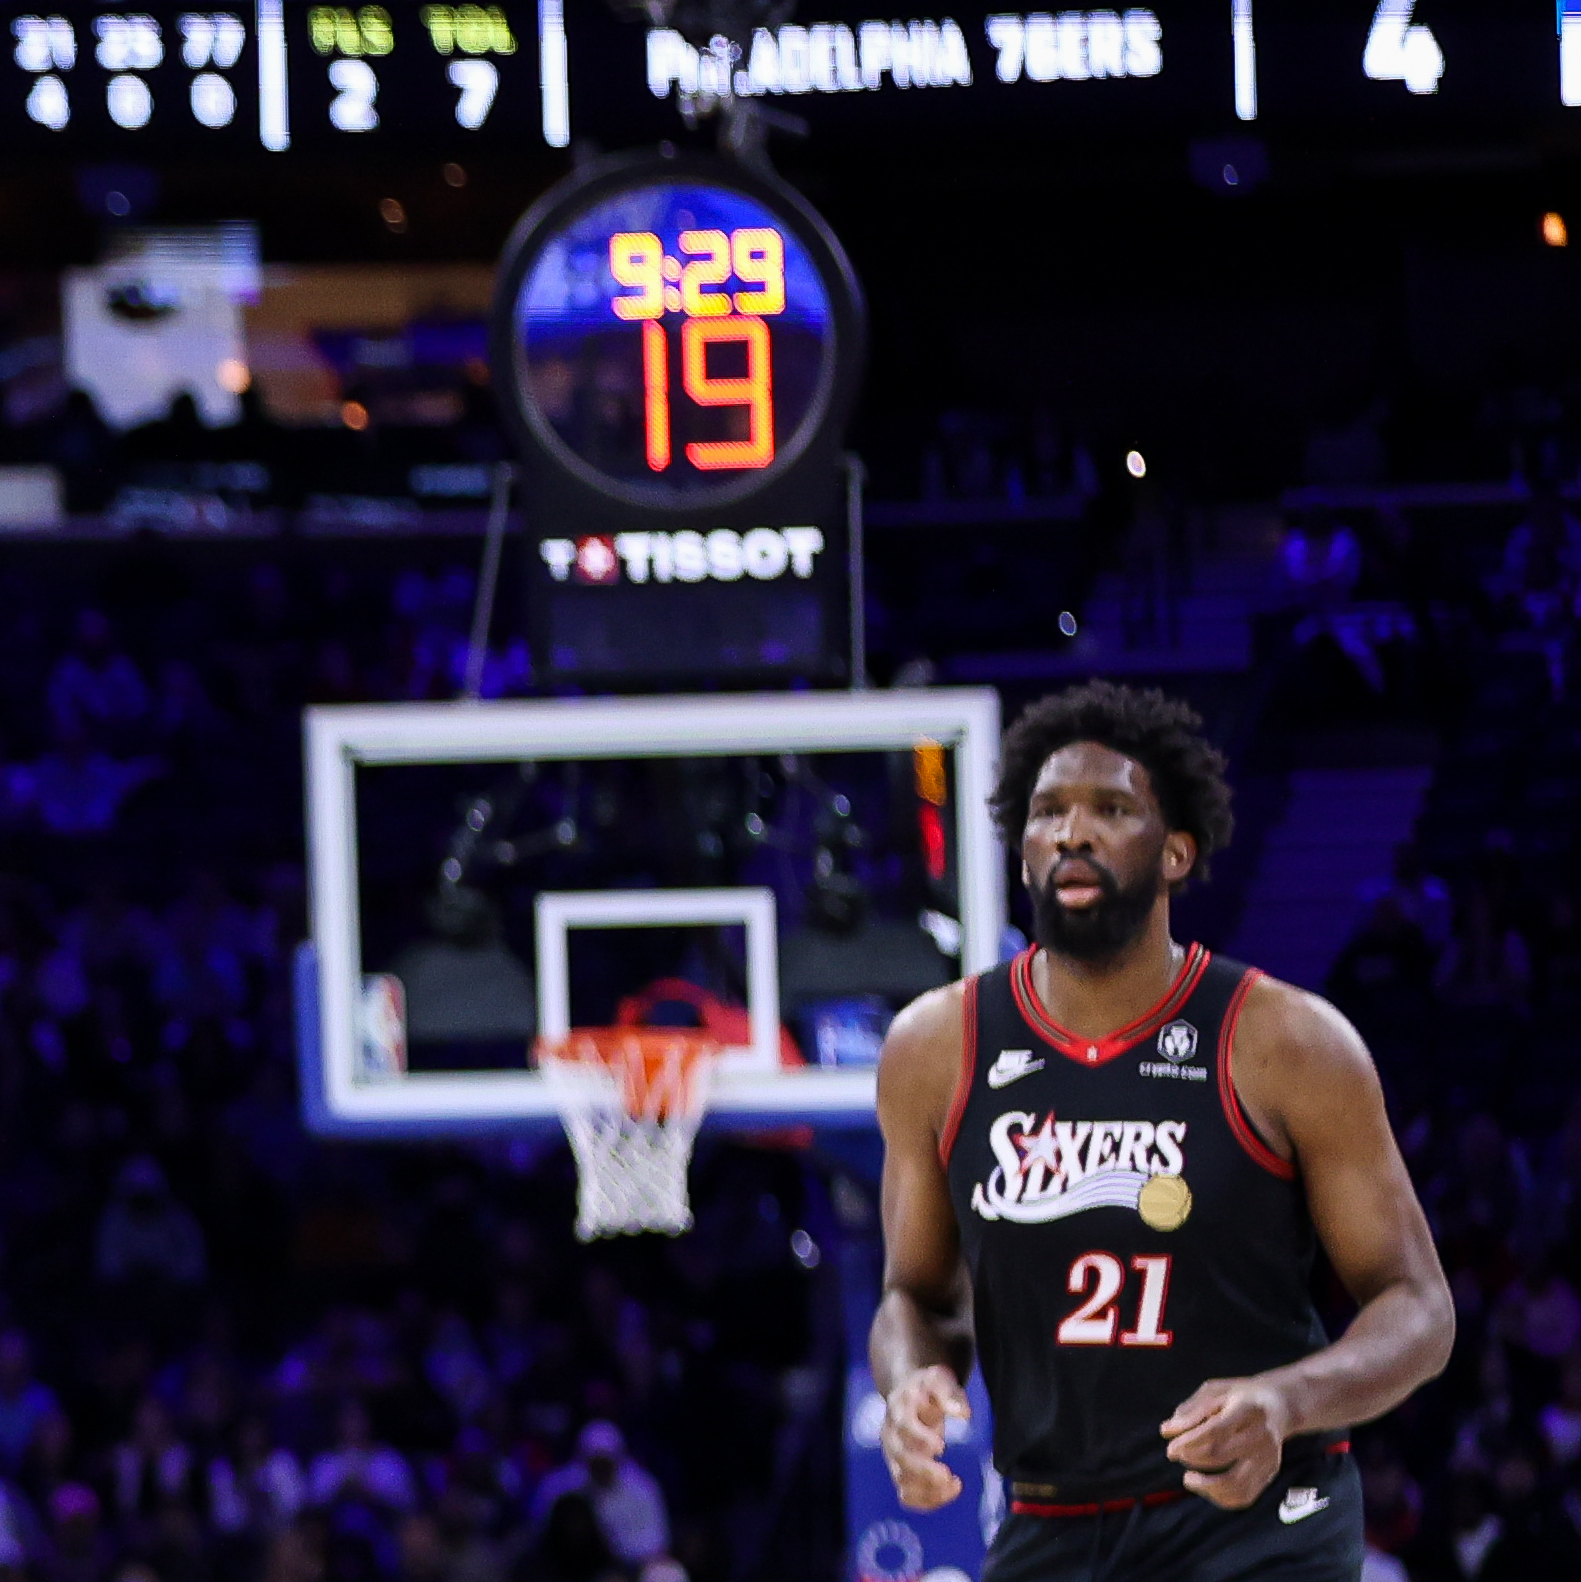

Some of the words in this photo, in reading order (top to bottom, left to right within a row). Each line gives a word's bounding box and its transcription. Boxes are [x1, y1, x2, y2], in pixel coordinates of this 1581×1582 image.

[986, 8, 1164, 84] 76ERS
[447, 59, 499, 130] 7
[609, 227, 787, 321] 9:29
[642, 316, 776, 472] 19
[615, 527, 825, 584] TISSOT
[987, 1110, 1187, 1206] SIXERS
[1055, 1250, 1175, 1348] 21
